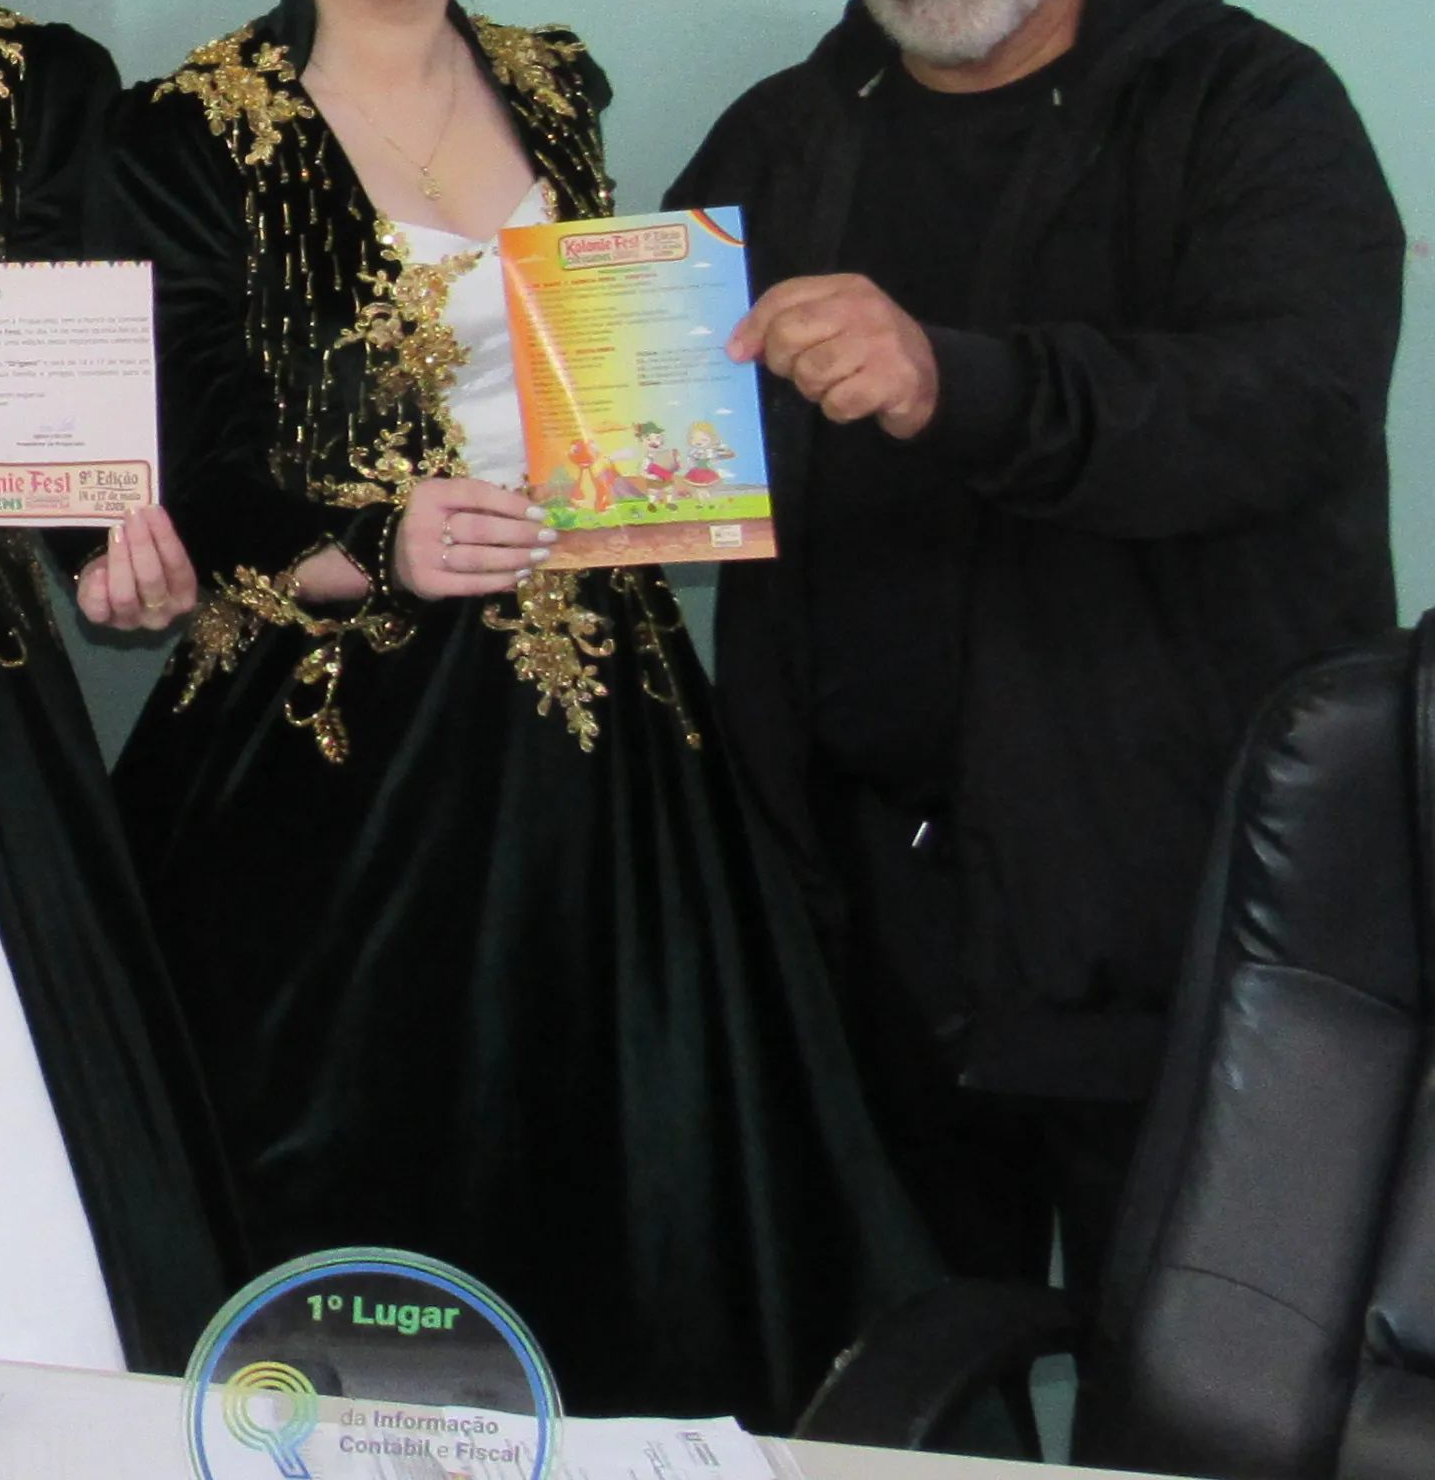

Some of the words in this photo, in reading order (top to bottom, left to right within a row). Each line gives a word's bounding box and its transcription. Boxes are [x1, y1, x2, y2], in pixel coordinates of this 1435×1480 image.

[26, 470, 71, 494] Fest
[96, 470, 139, 487] Edição
[307, 1295, 344, 1321] 1º
[352, 1296, 460, 1335] Lugar
[340, 1408, 366, 1426] da
[373, 1410, 499, 1436] Informação
[339, 1434, 431, 1458] Contábil
[436, 1443, 449, 1457] e
[456, 1442, 520, 1463] Fiscal
